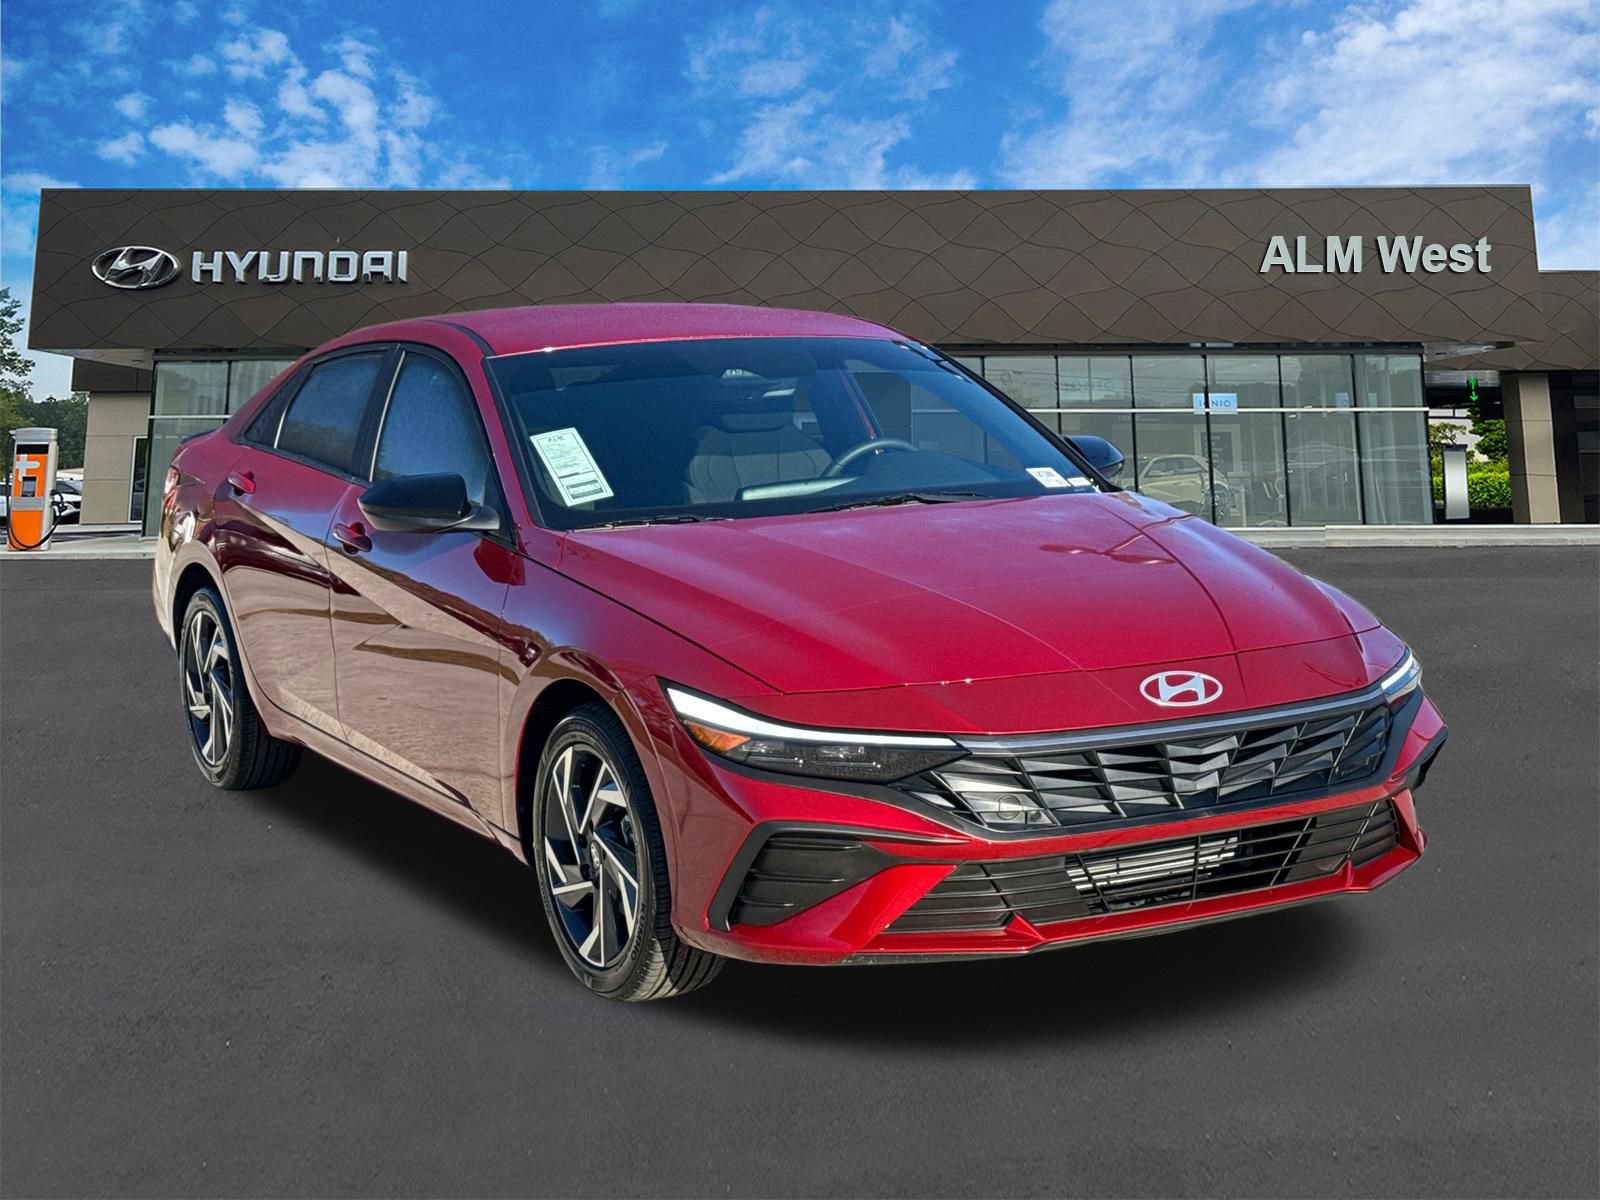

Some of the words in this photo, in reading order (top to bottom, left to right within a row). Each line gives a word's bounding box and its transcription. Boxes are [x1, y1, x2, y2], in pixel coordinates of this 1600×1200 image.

[192, 250, 409, 284] HYUNDAI
[1260, 235, 1363, 273] ALM
[1377, 235, 1492, 273] West
